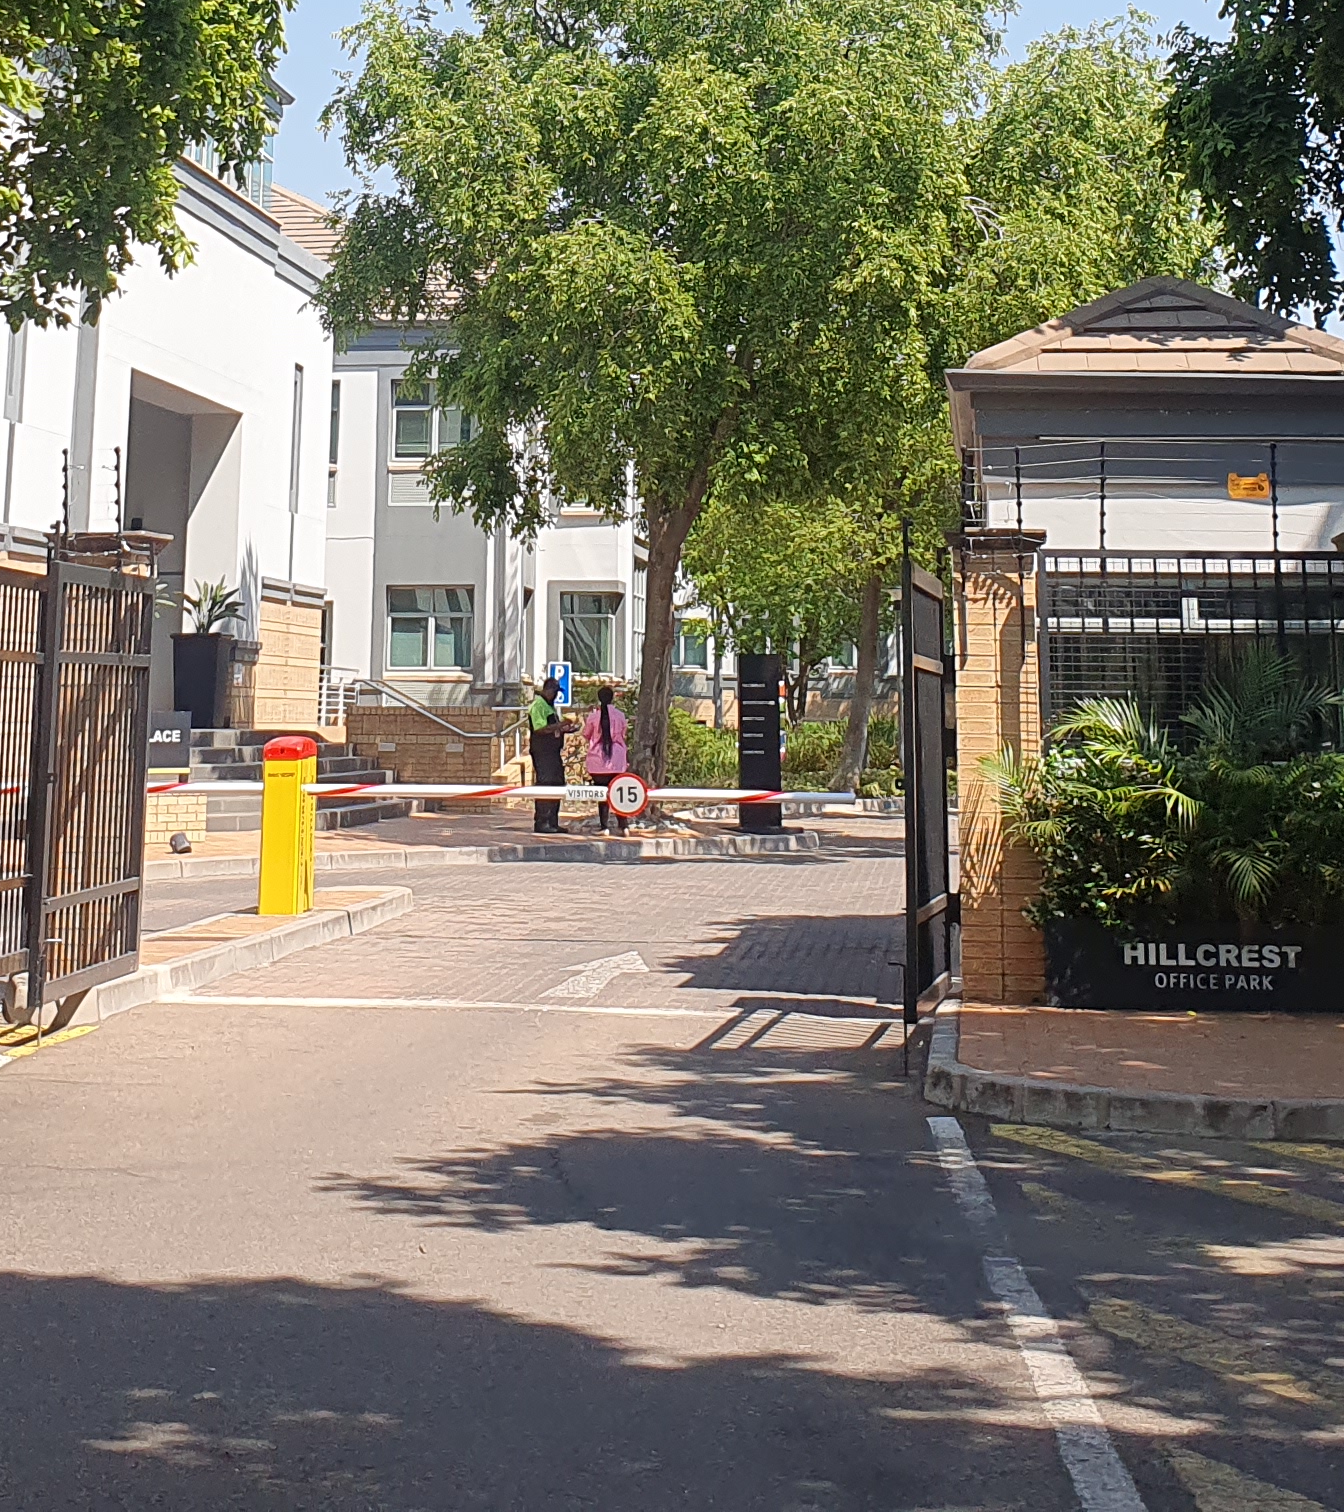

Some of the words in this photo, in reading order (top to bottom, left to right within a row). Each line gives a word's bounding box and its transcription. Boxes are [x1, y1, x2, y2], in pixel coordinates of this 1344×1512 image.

[148, 729, 182, 743] ACE
[567, 788, 605, 799] VISITORS
[616, 786, 638, 804] 15
[1123, 942, 1303, 969] HILLCREST
[1155, 972, 1219, 990] OFFICE
[1224, 974, 1275, 991] PARK
